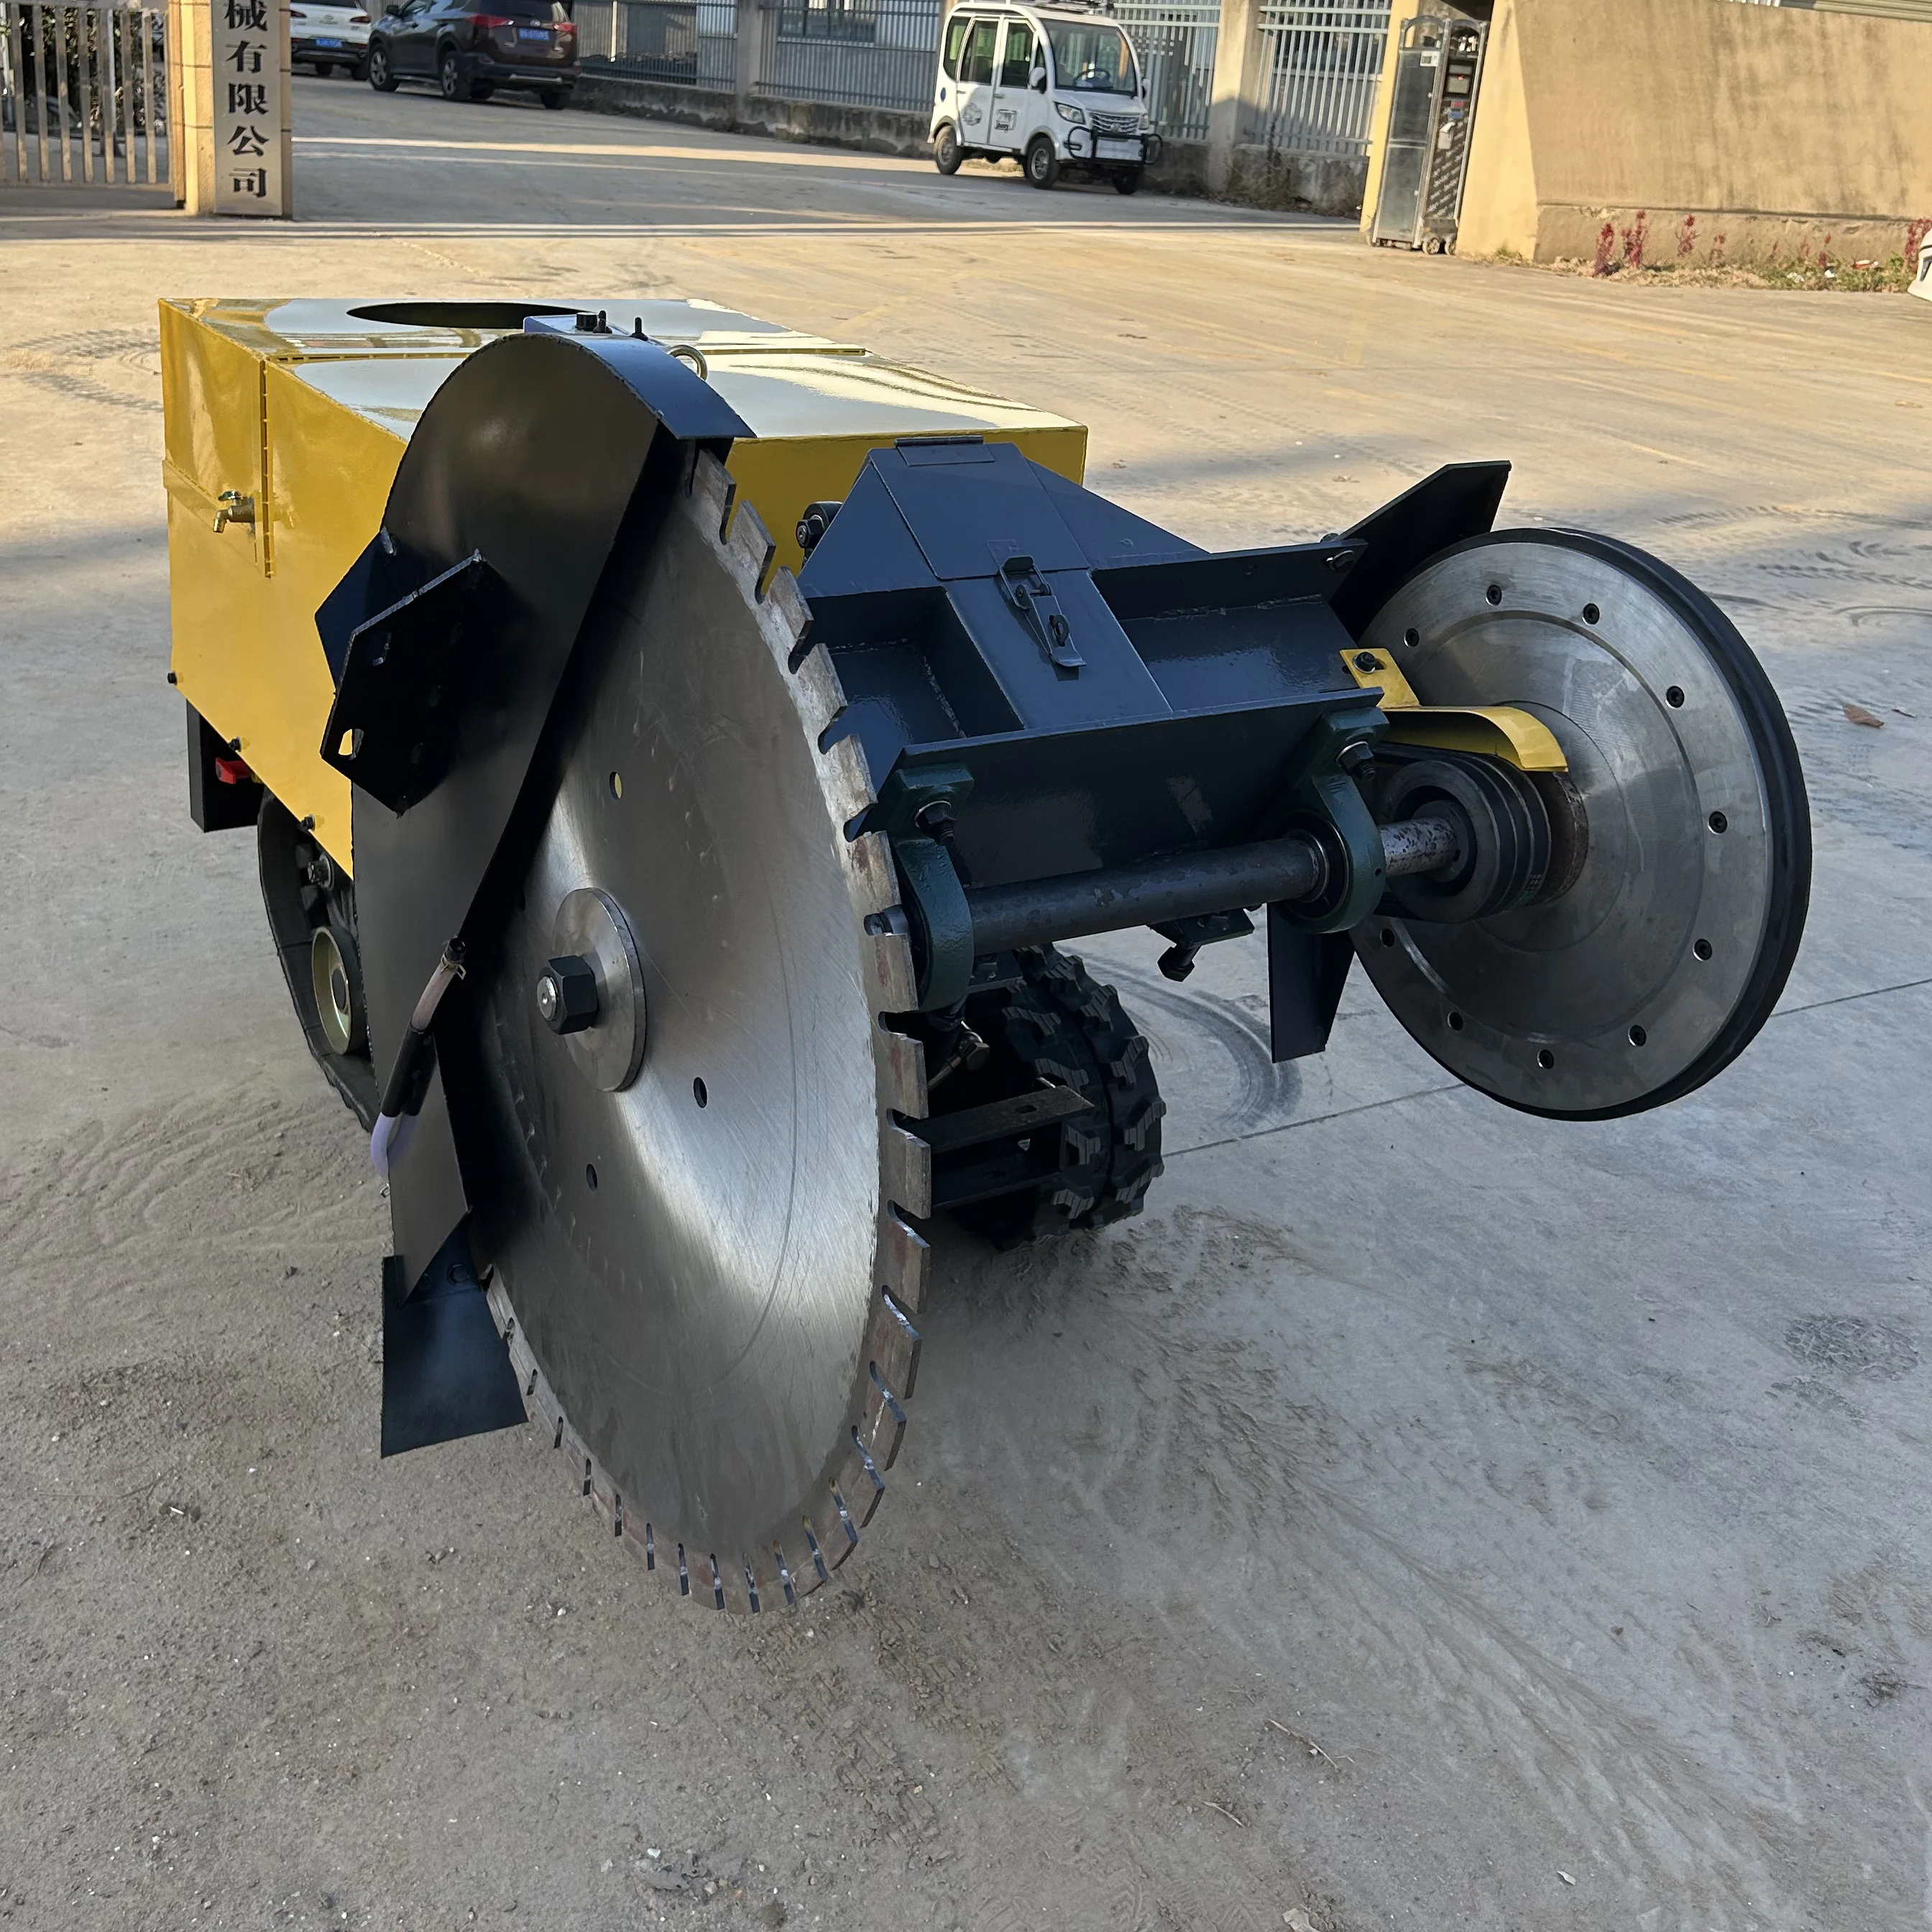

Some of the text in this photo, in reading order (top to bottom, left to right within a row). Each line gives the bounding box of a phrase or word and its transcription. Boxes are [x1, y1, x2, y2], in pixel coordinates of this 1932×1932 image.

[224, 0, 270, 198] 械有限公司
